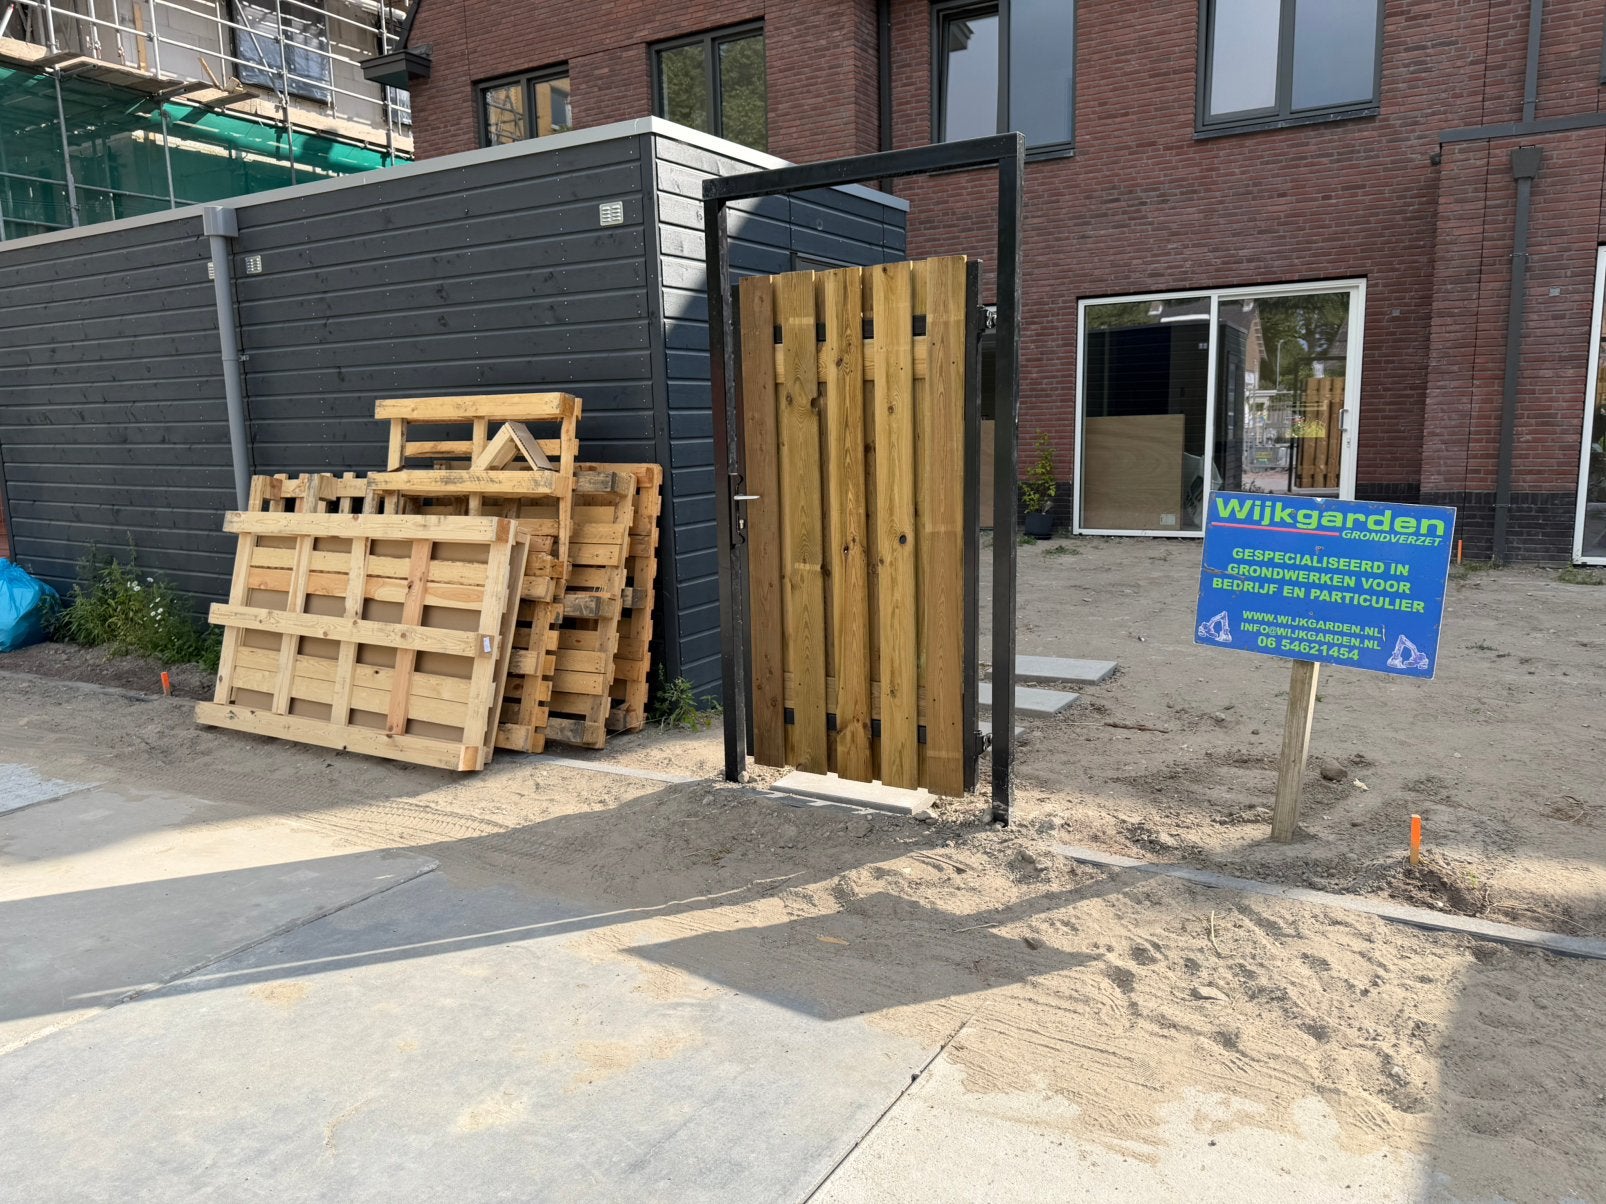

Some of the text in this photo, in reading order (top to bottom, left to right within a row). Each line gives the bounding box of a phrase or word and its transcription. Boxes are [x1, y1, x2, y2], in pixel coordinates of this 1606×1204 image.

[1215, 497, 1445, 536] Wijkgarden
[1342, 530, 1442, 547] GRONDVERZET
[1233, 548, 1410, 576] GESPECIALISEERD IN
[1228, 564, 1411, 594] GRONDWERKEN VOOR
[1213, 578, 1425, 613] BEDRIJF EN PARTICULIER
[1241, 623, 1381, 650] INFO@WIJKGARDEN.NL
[1243, 612, 1381, 637] WWW.WIJKGARDEN.NL
[1258, 636, 1359, 661] 06 54621454
